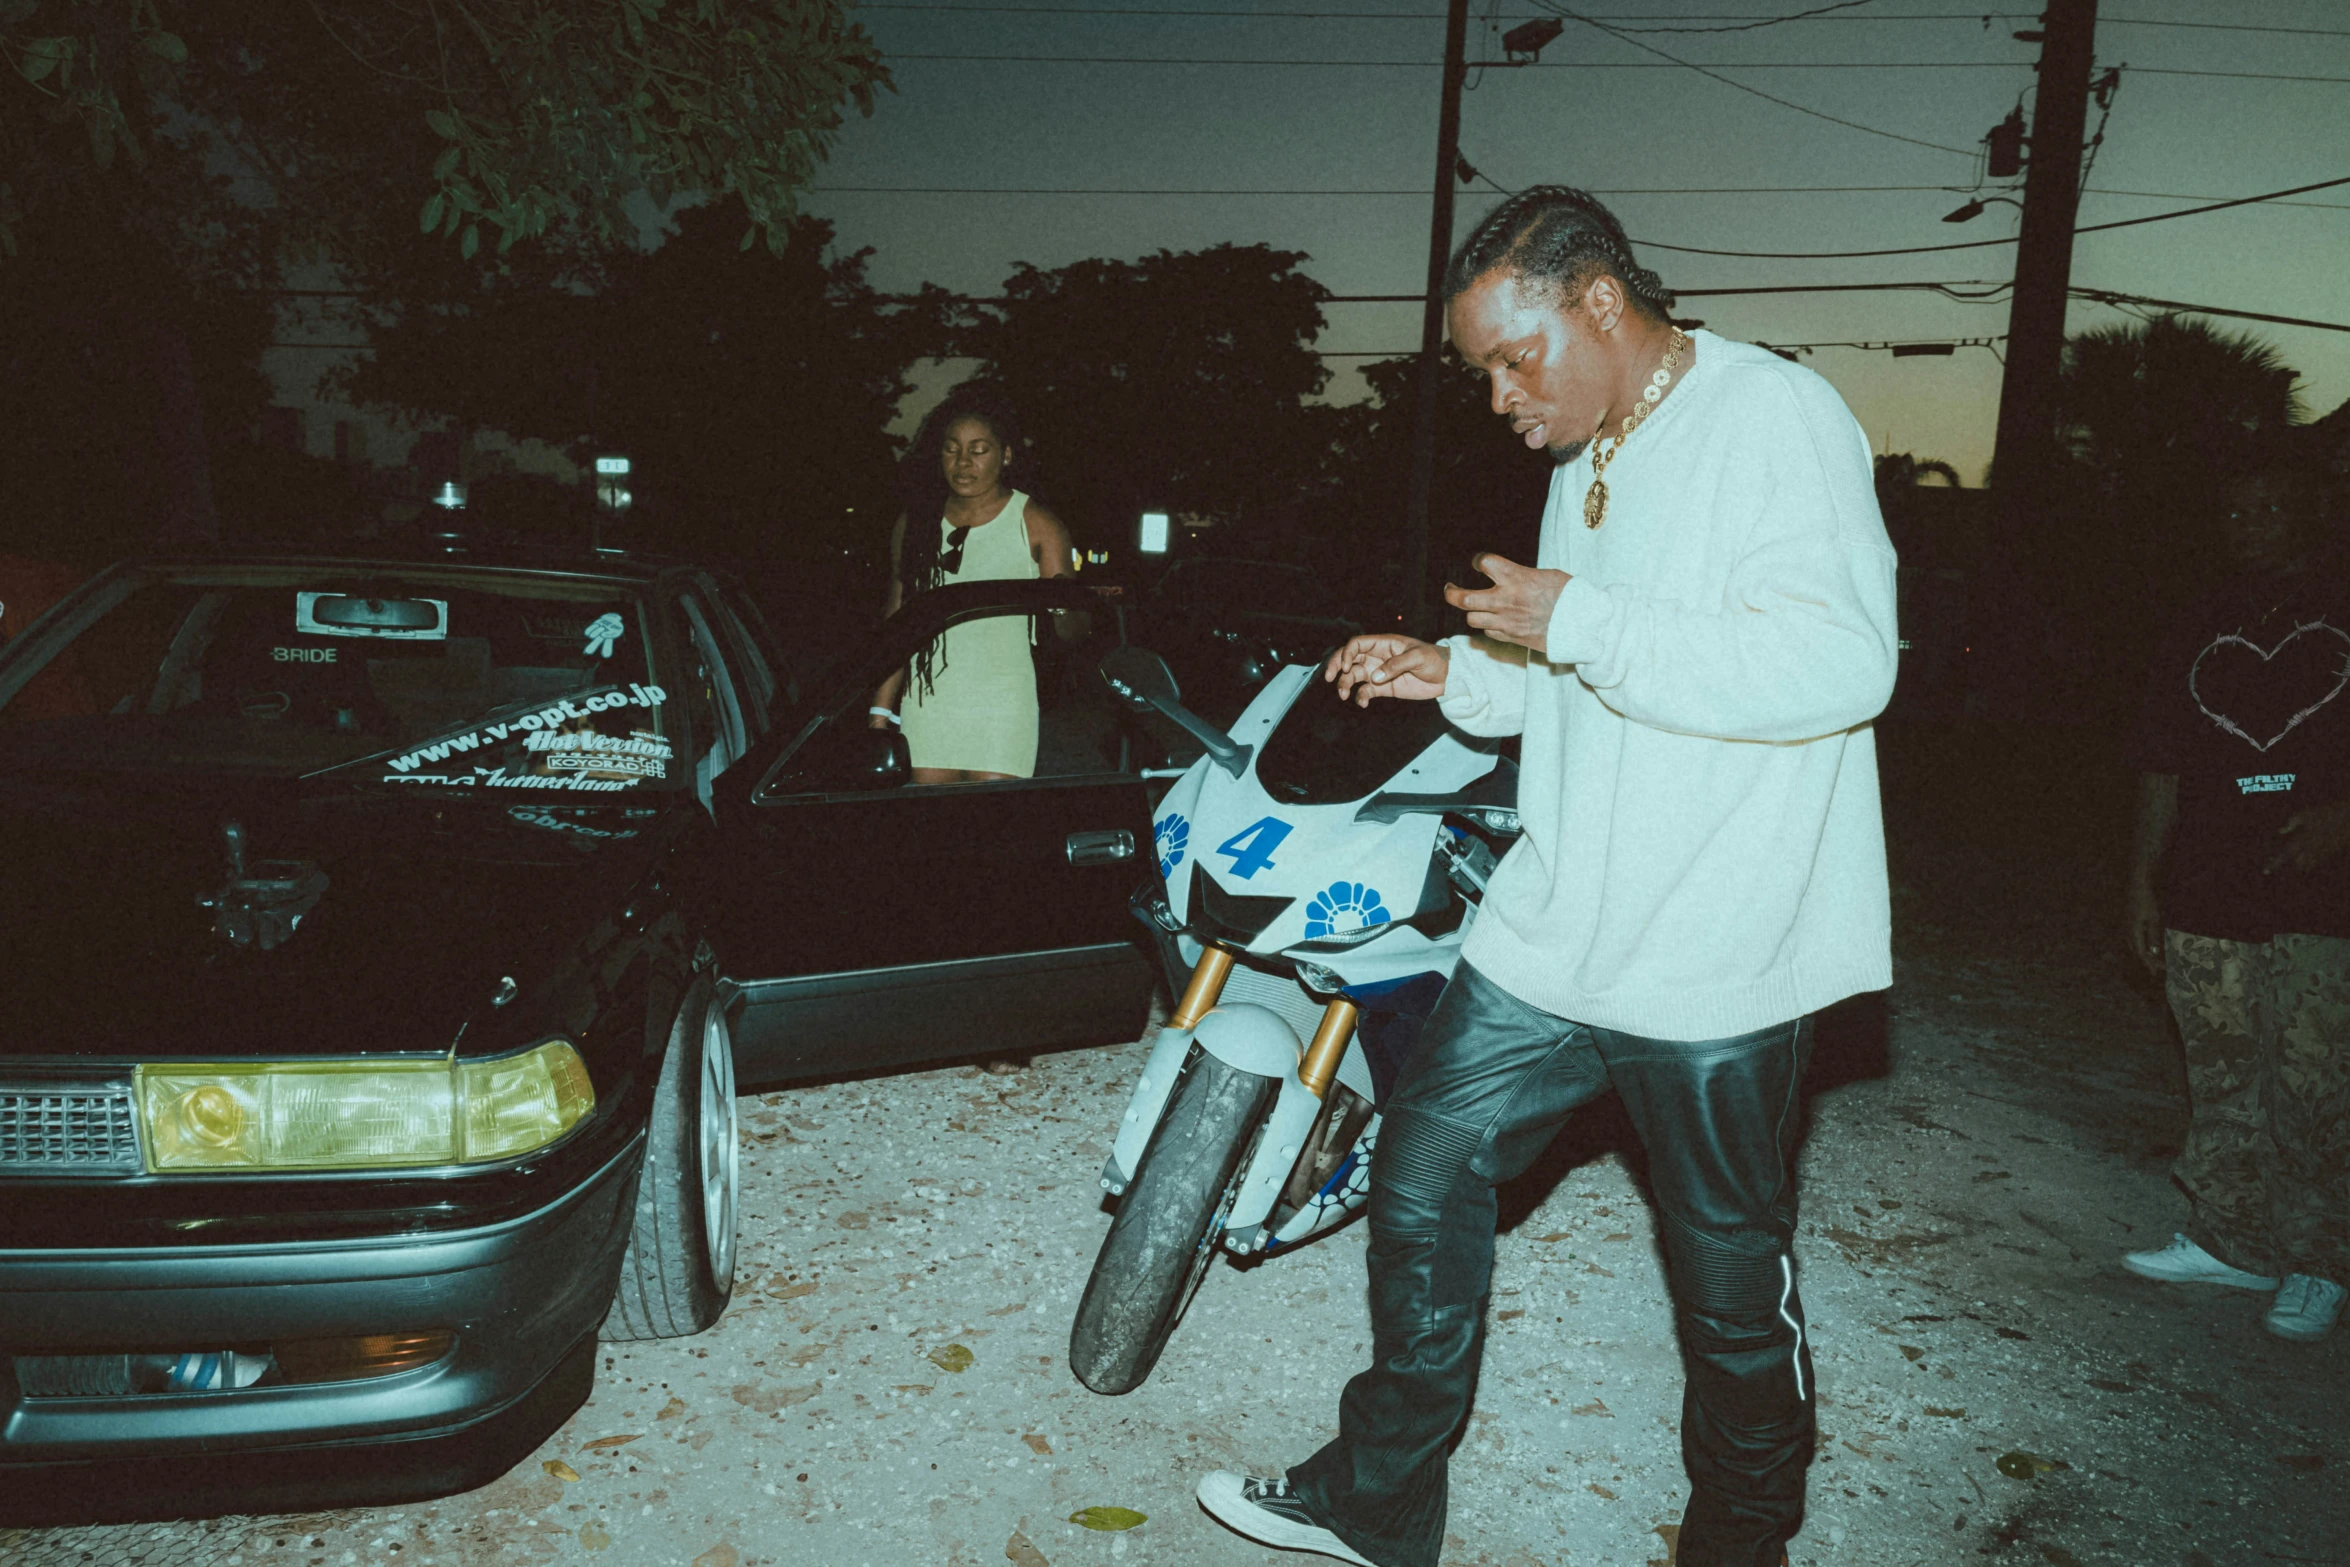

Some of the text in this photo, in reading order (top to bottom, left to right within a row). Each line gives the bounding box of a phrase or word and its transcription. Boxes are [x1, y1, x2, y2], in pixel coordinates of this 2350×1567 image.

[271, 647, 338, 663] BRIDE
[387, 682, 667, 773] www.v-opt.co.jp
[522, 730, 580, 752] Hot
[580, 730, 674, 760] Version
[551, 758, 640, 771] KOYORAD
[2236, 773, 2297, 787] THE FILTHY
[1216, 815, 1295, 880] 4
